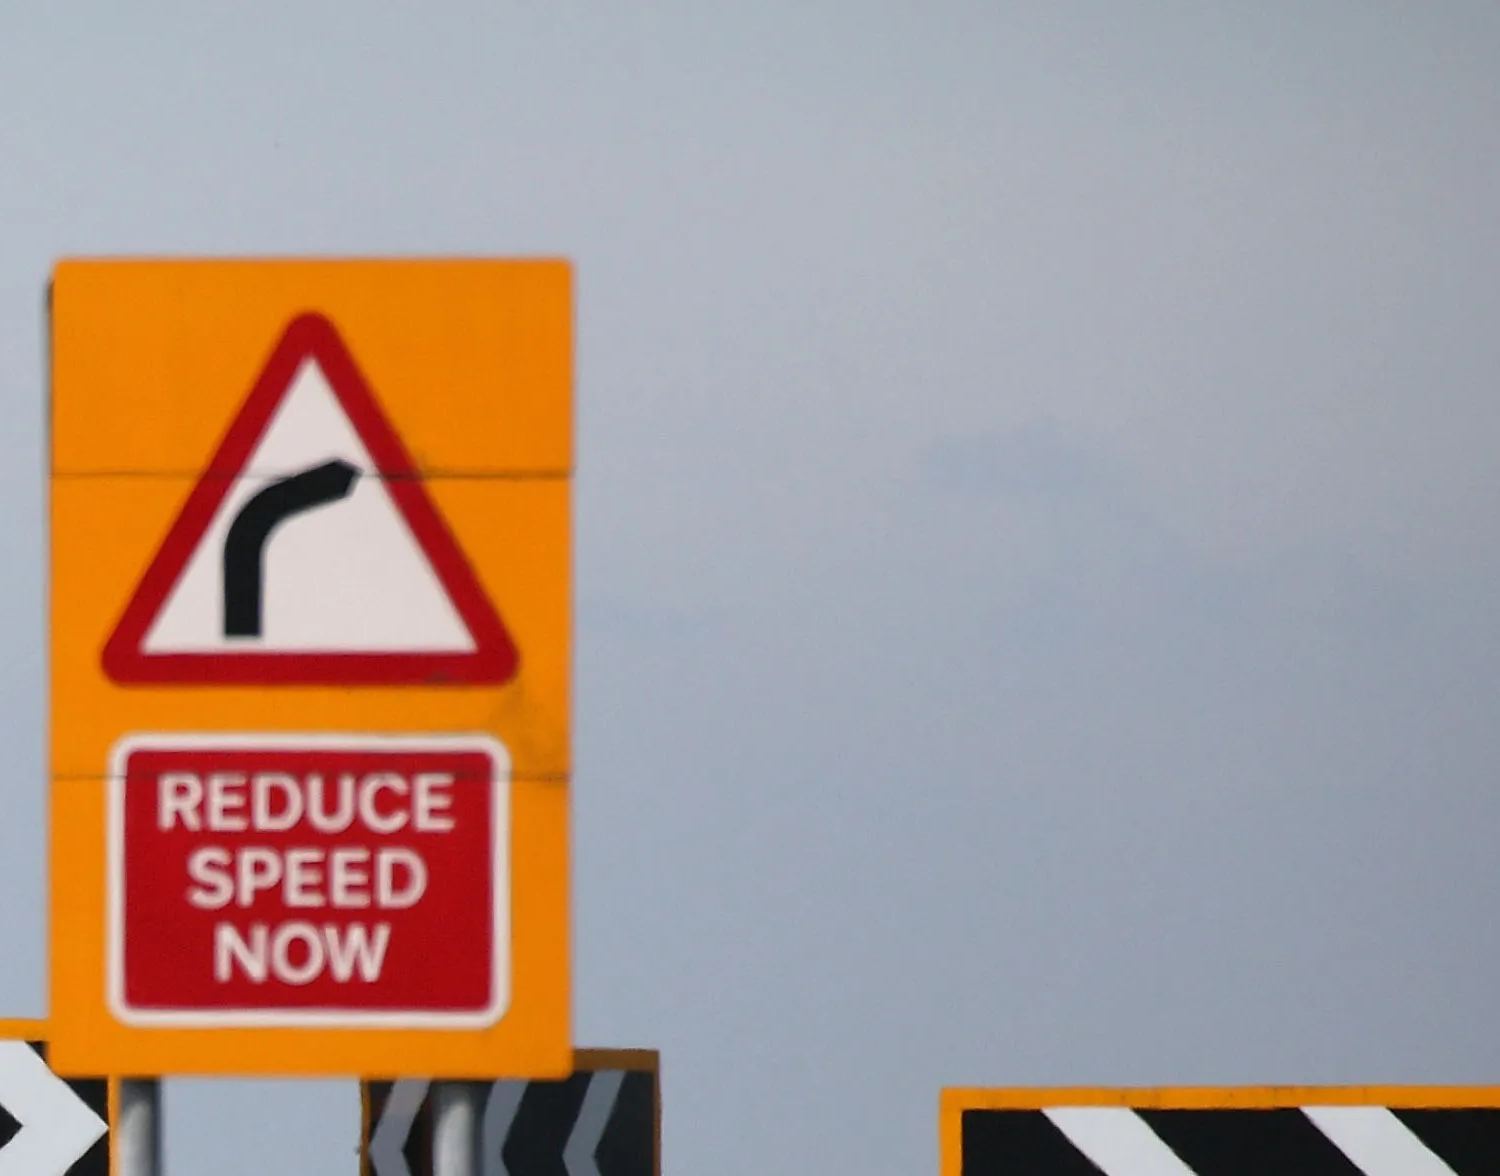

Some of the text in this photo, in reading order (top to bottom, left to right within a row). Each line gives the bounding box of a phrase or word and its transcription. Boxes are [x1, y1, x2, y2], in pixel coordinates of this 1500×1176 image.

[158, 772, 455, 833] REDUCE
[188, 846, 428, 909] SPEED
[215, 921, 390, 984] NOW
